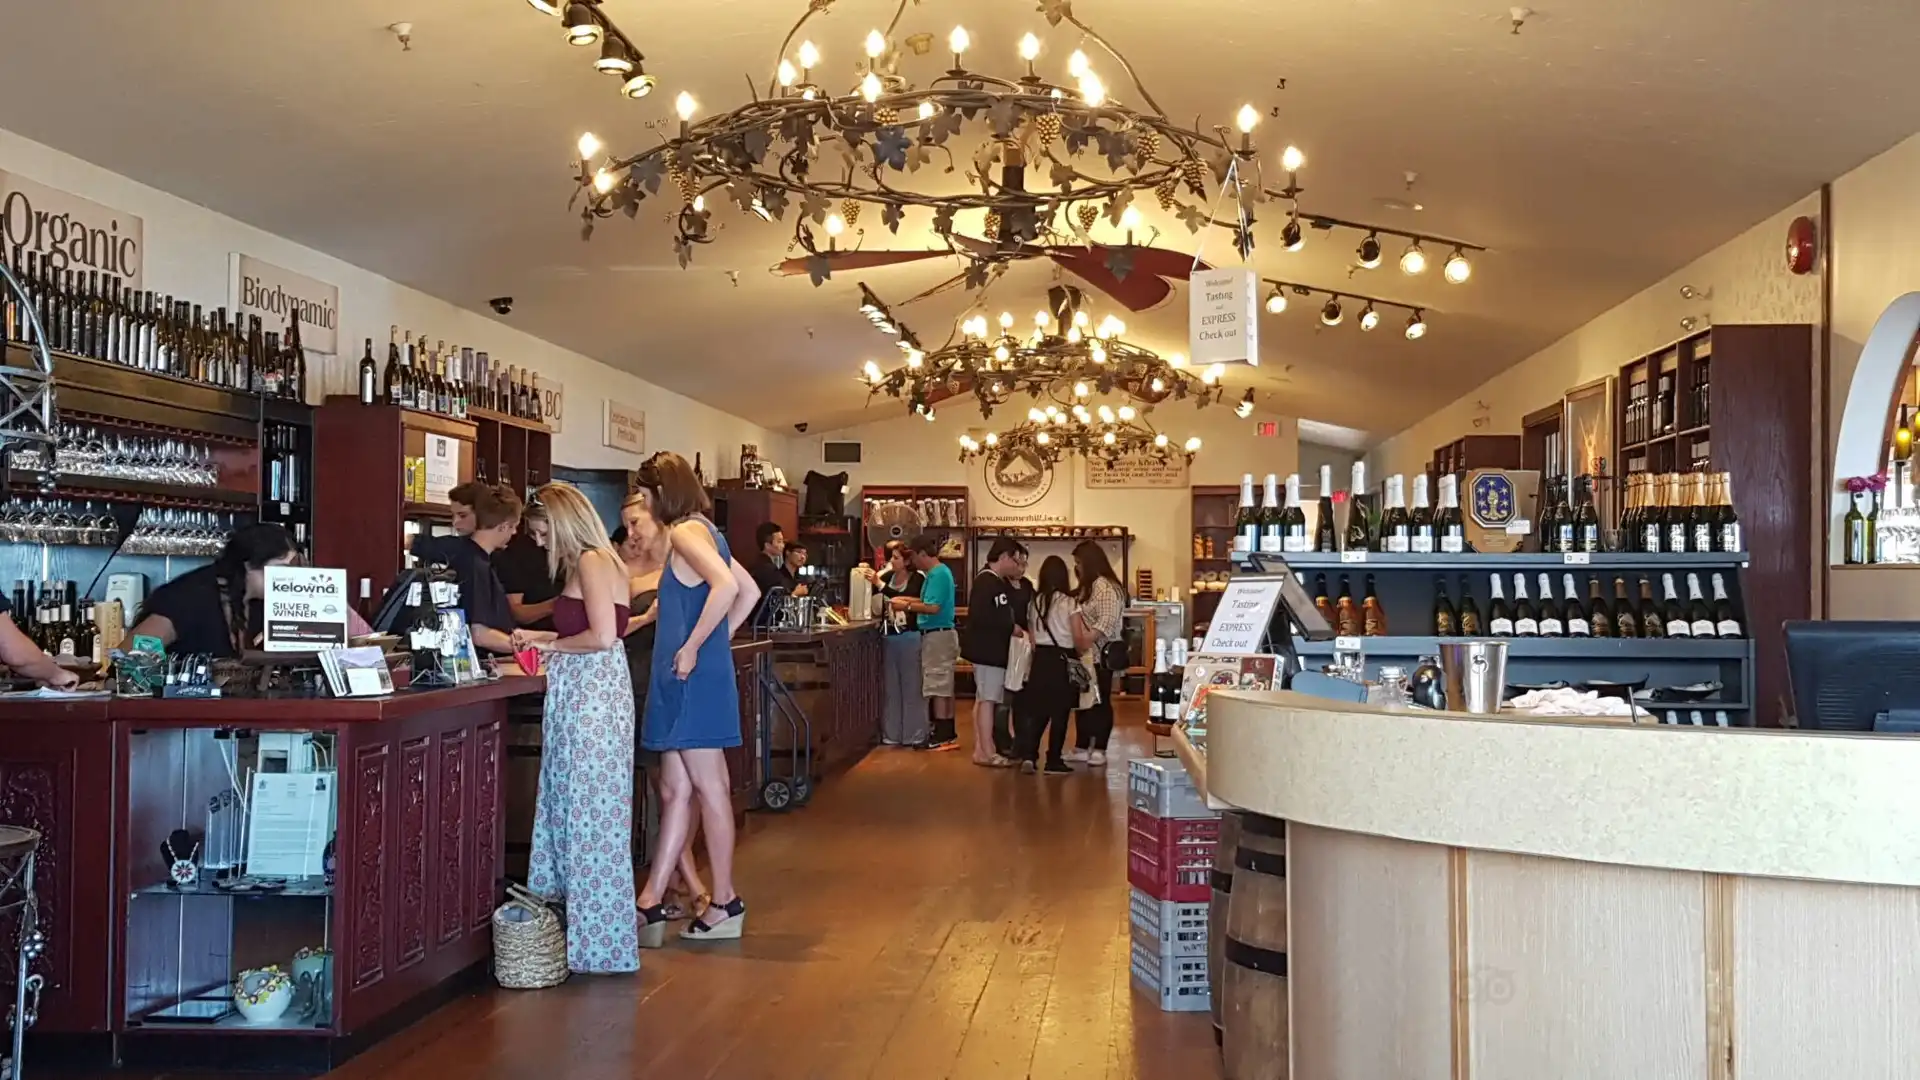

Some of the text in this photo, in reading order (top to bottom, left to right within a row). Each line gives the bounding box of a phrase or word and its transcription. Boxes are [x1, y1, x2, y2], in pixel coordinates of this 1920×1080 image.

[3, 191, 137, 278] Organic
[242, 276, 336, 330] Biodynamic
[1206, 291, 1233, 303] Tasting
[1201, 312, 1236, 326] EXPRESS
[1199, 328, 1237, 341] Check out
[272, 582, 335, 594] kelowna
[272, 602, 310, 611] SILVER
[273, 609, 318, 619] WINNER
[1218, 622, 1254, 632] EXPRESS
[1211, 638, 1248, 648] Check out
